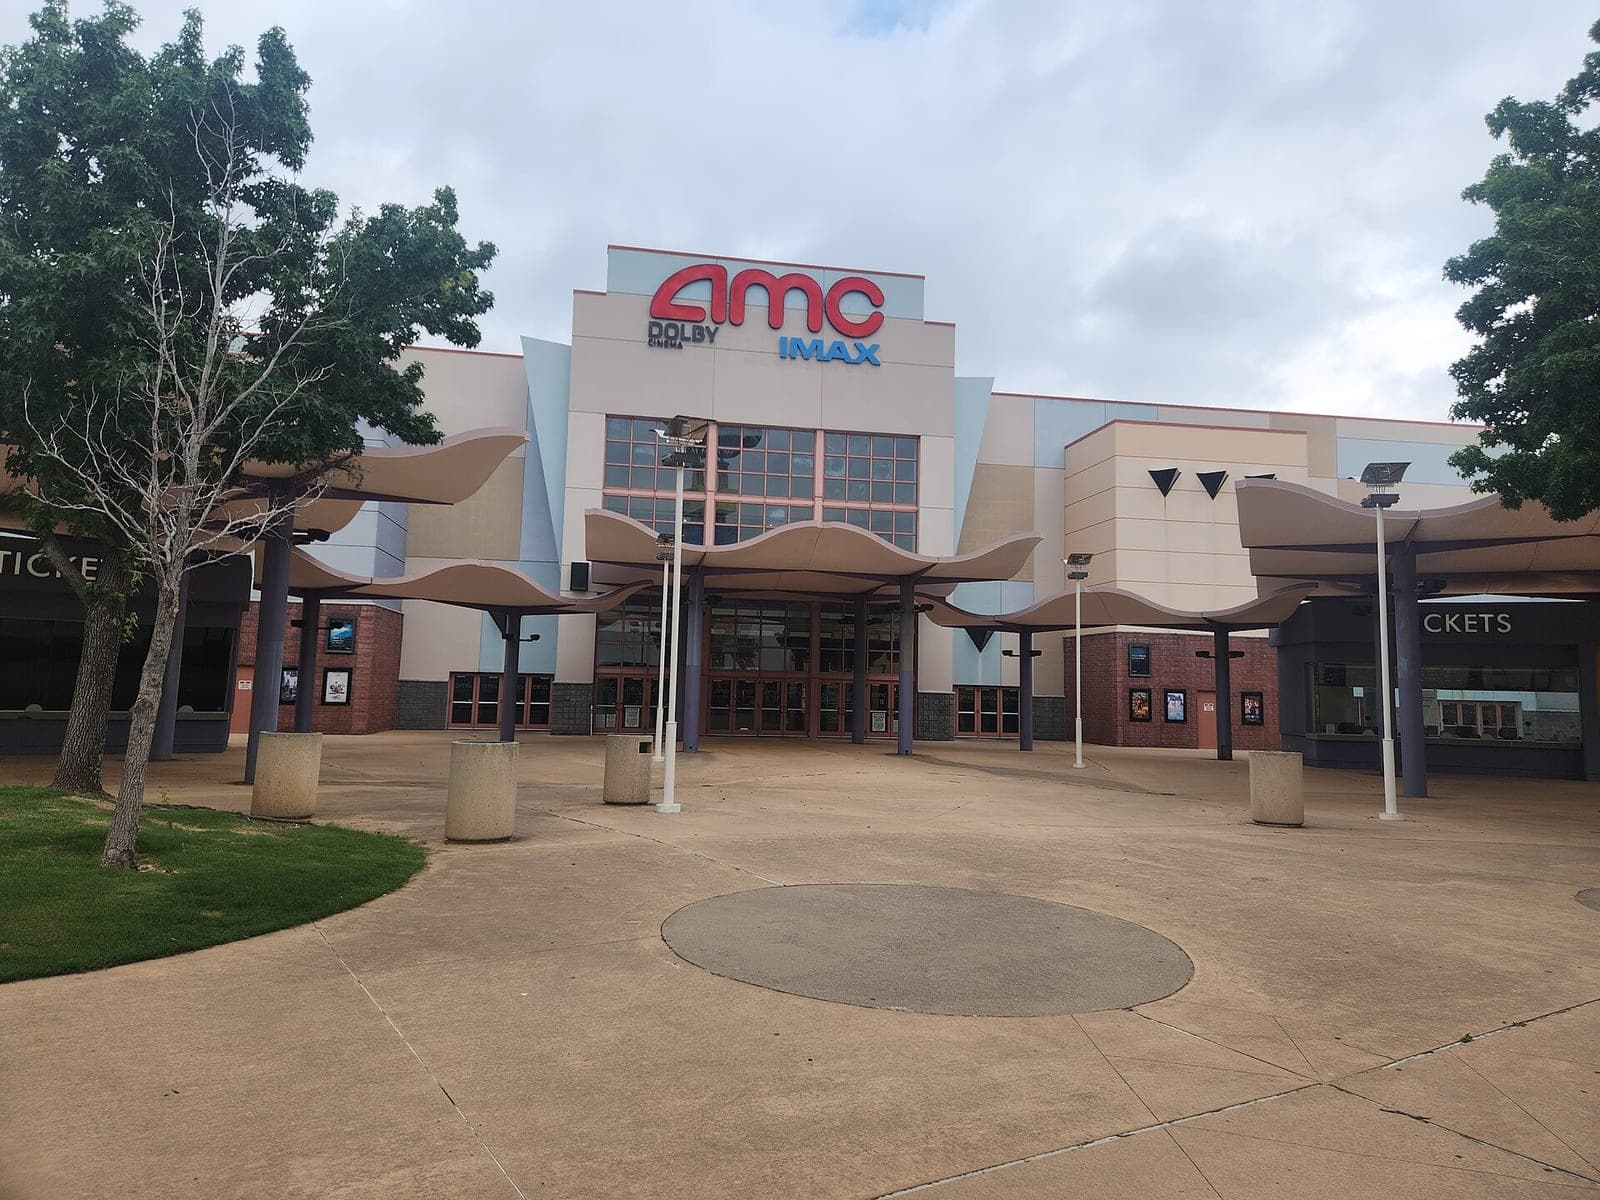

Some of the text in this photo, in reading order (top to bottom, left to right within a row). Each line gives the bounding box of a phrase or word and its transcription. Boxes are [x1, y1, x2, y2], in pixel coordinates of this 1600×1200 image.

[648, 321, 719, 344] DOLBY
[648, 338, 683, 350] CINEMA
[779, 336, 881, 366] IMAX
[0, 550, 104, 580] TICE
